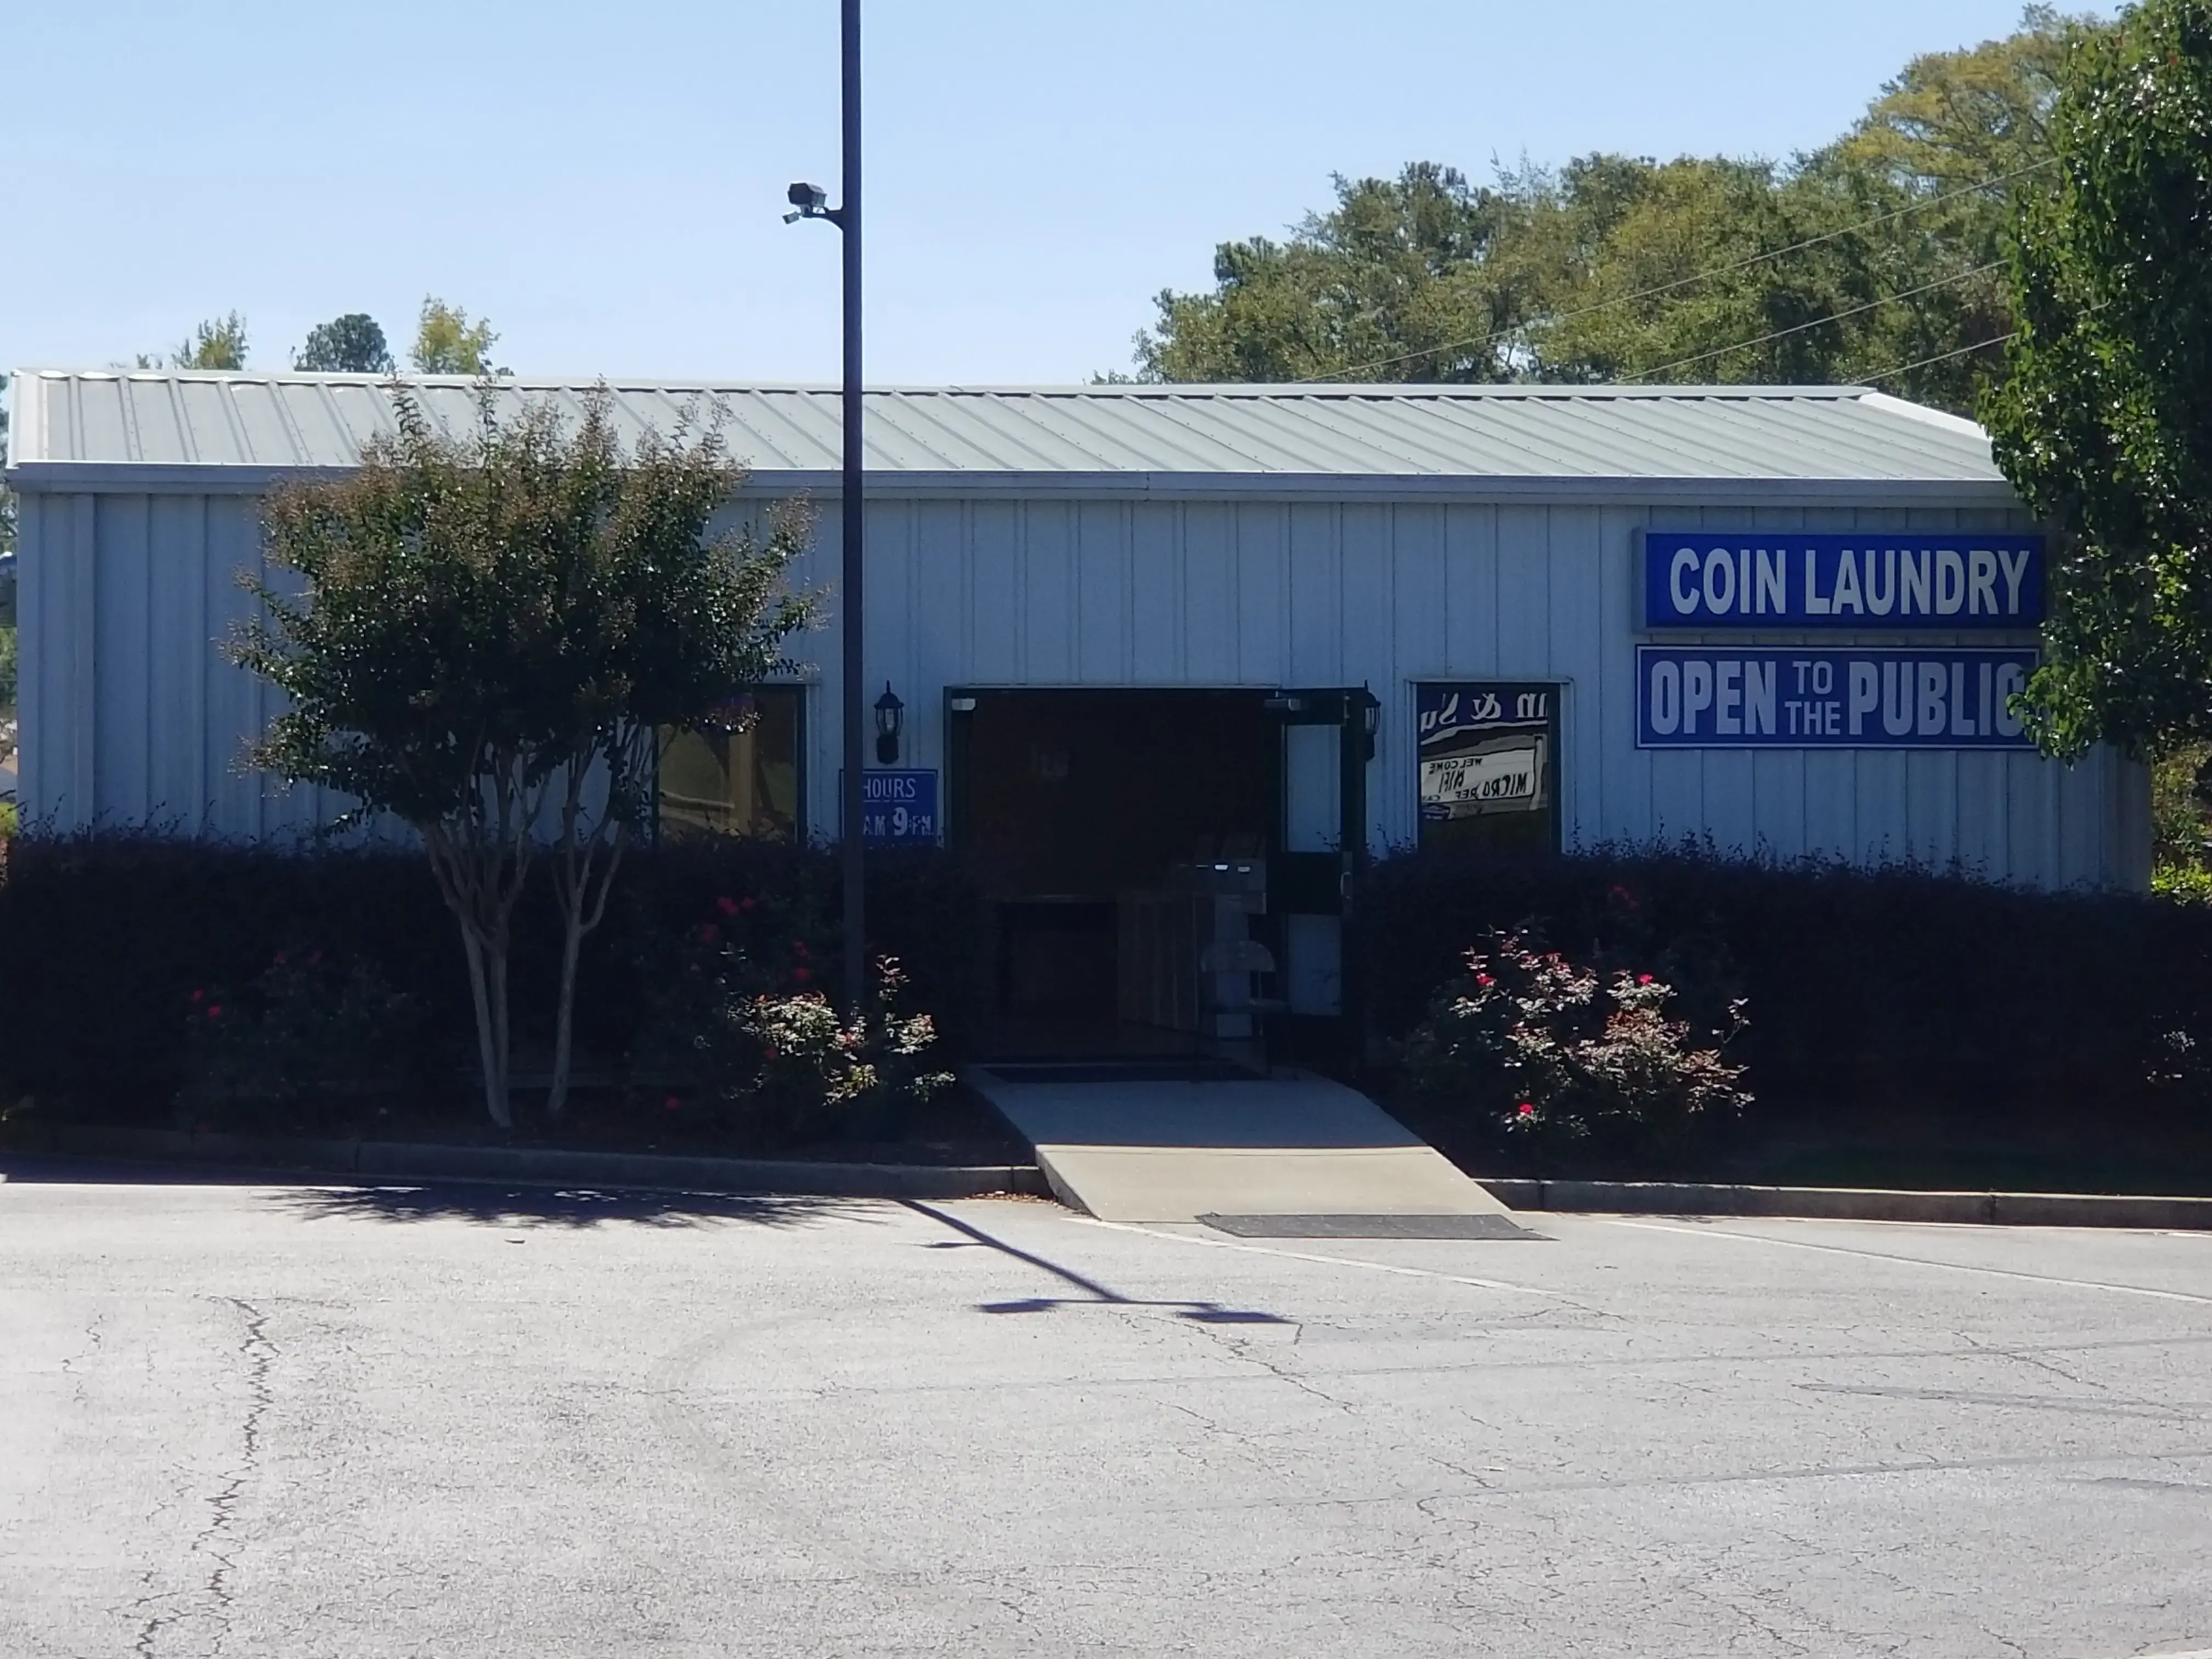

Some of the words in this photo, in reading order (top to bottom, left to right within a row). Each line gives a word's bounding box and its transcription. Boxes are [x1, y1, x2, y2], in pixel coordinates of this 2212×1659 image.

[1669, 547, 1786, 616] COIN
[1804, 549, 2030, 616] LAUNDRY
[1650, 660, 1777, 735] OPEN
[1792, 660, 1833, 695] TO
[1848, 661, 2025, 737] PUBLIC
[1784, 701, 1841, 735] THE
